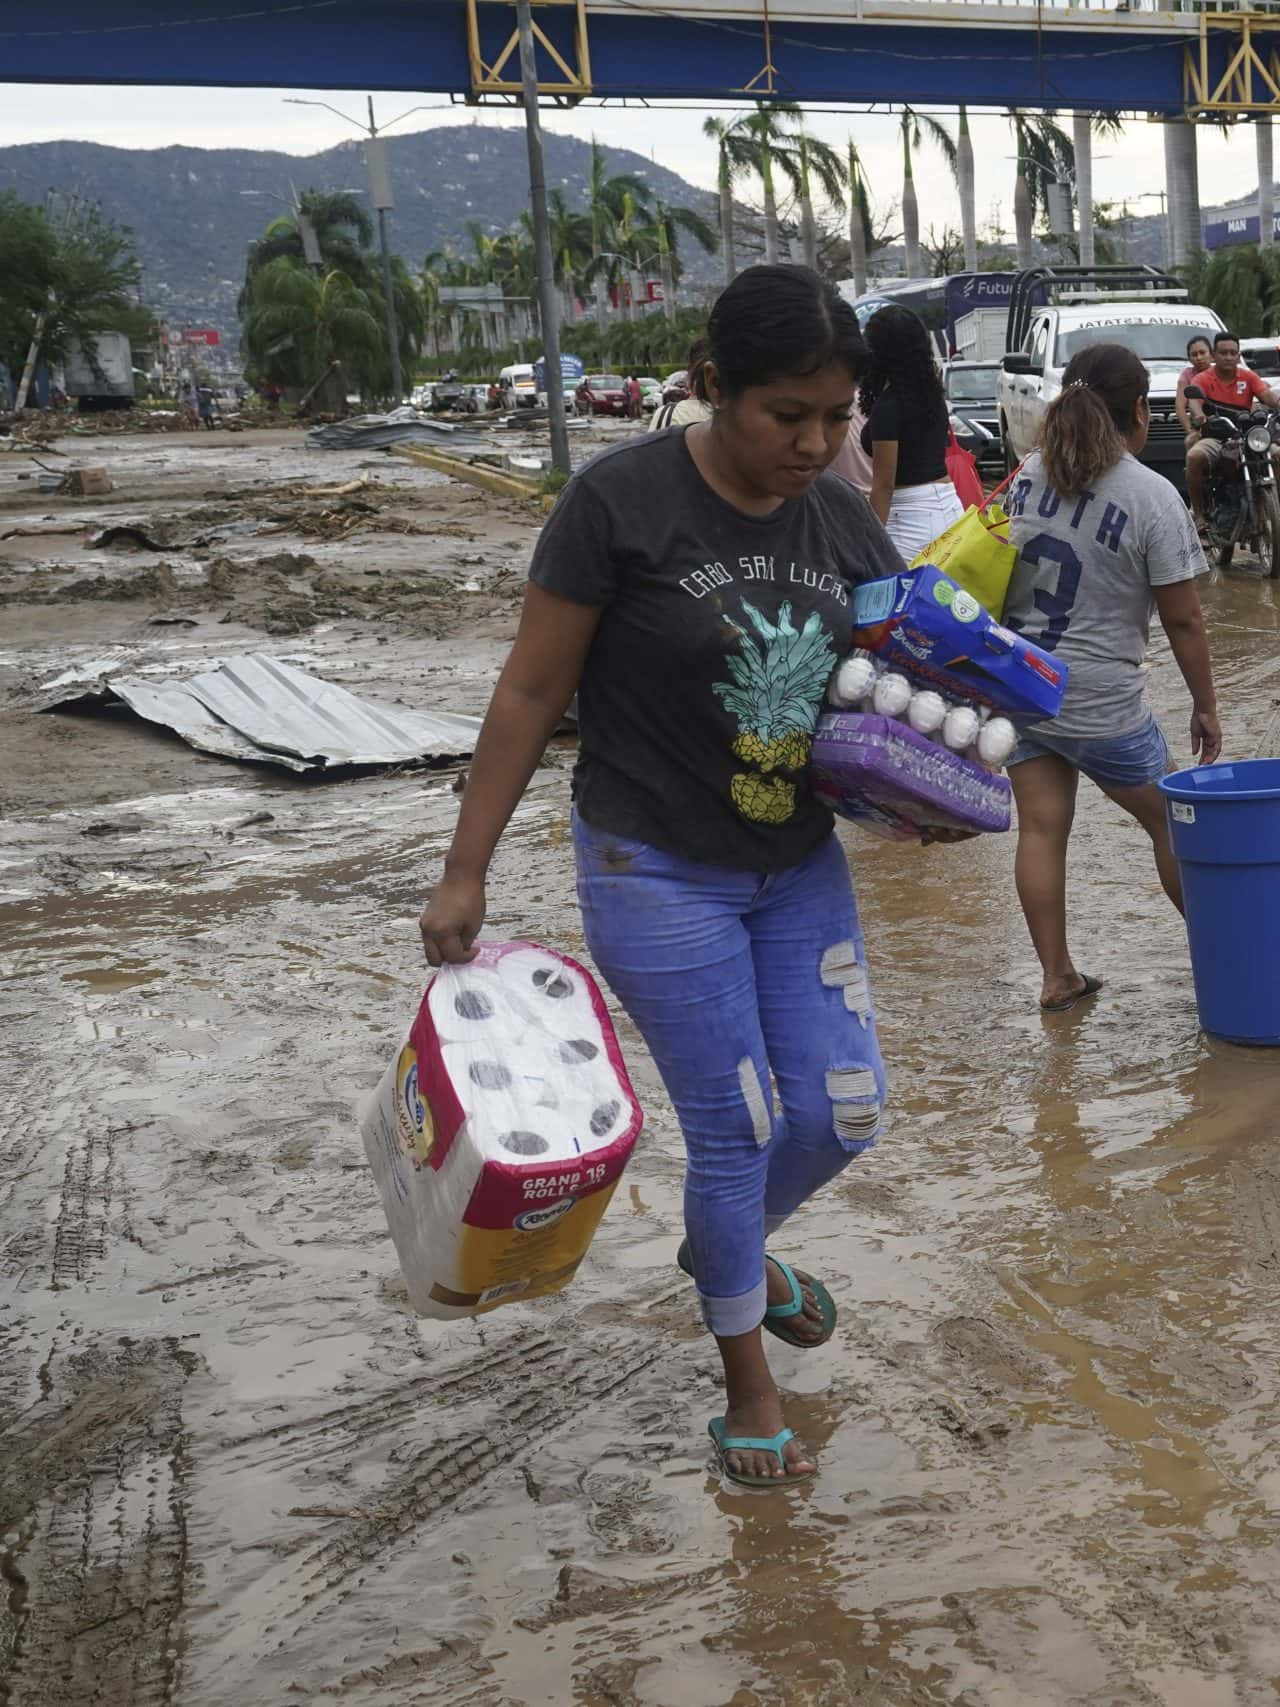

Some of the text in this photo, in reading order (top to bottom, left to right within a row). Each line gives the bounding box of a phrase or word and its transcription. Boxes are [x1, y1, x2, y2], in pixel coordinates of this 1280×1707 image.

[1227, 218, 1247, 234] MAN
[1008, 478, 1129, 554] RUTH
[679, 561, 734, 599] CABO
[738, 556, 776, 581] SAN
[789, 562, 848, 607] LUCAS
[1006, 532, 1083, 653] 3
[522, 1171, 581, 1190] GRAND
